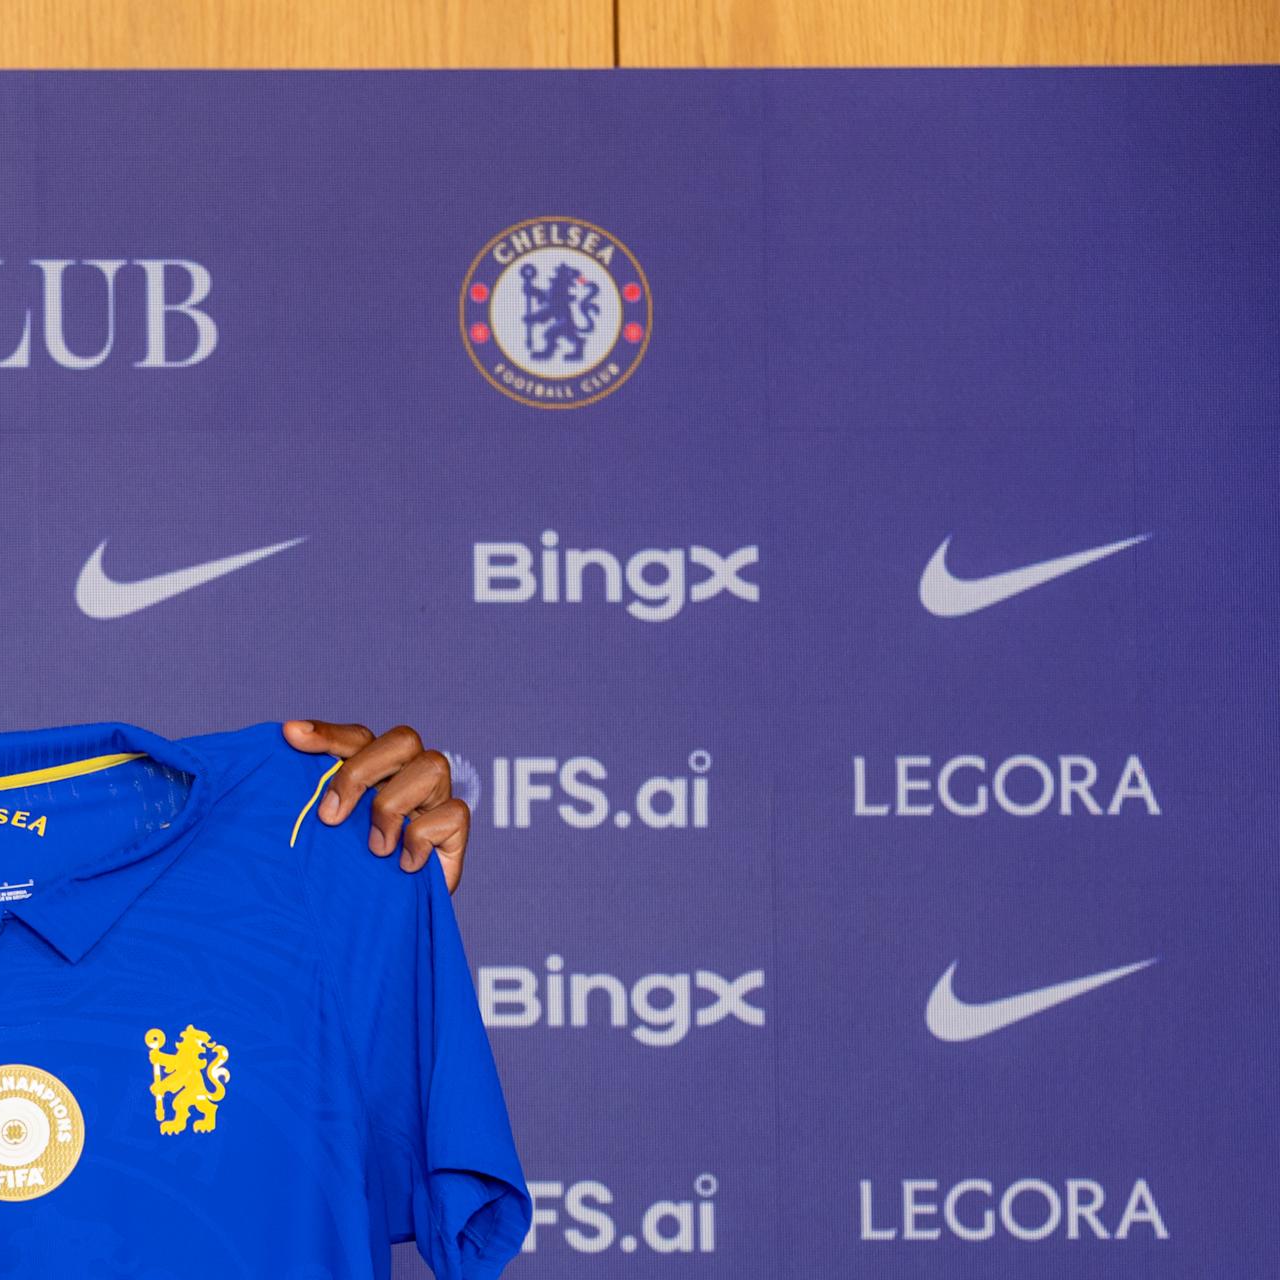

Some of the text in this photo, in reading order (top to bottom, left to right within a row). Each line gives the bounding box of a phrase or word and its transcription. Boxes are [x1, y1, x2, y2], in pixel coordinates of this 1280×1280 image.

[493, 224, 616, 266] CHELSEA
[494, 362, 620, 398] FOOTBALL CLUB
[494, 751, 710, 828] IFS.ai
[854, 755, 1160, 816] LEGORA
[522, 1174, 716, 1252] FS.ai
[860, 1179, 1168, 1240] LEGORA
